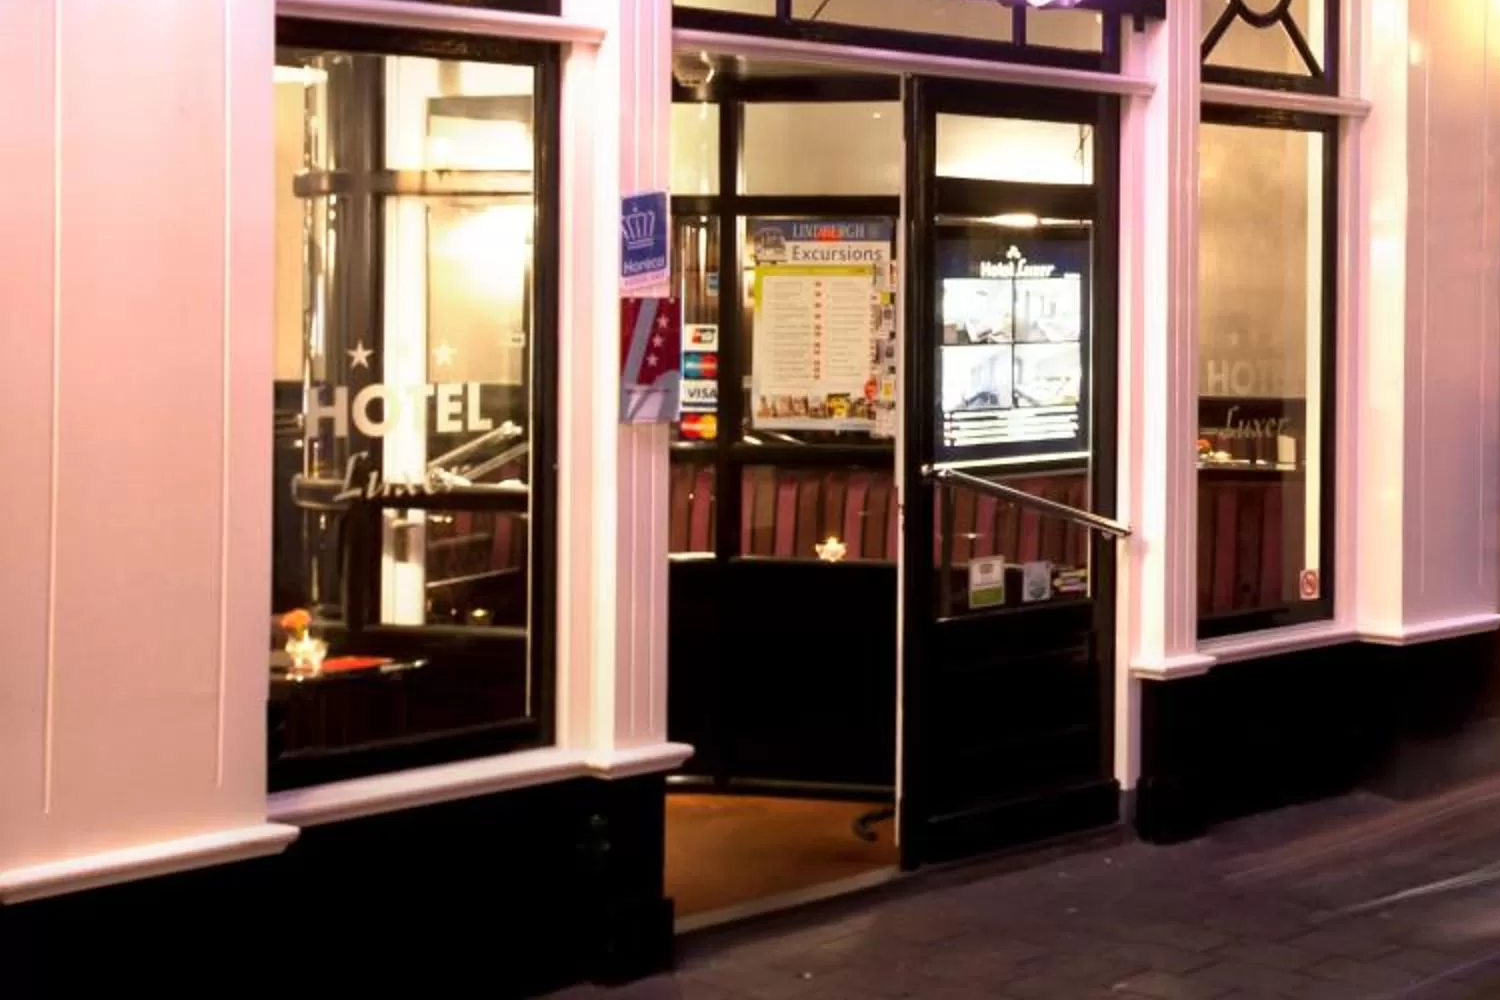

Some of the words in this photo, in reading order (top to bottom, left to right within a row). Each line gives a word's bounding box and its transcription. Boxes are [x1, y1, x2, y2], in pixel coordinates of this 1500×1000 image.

[791, 244, 883, 261] Excursions
[686, 385, 718, 400] VISA
[304, 382, 494, 439] HOTEL
